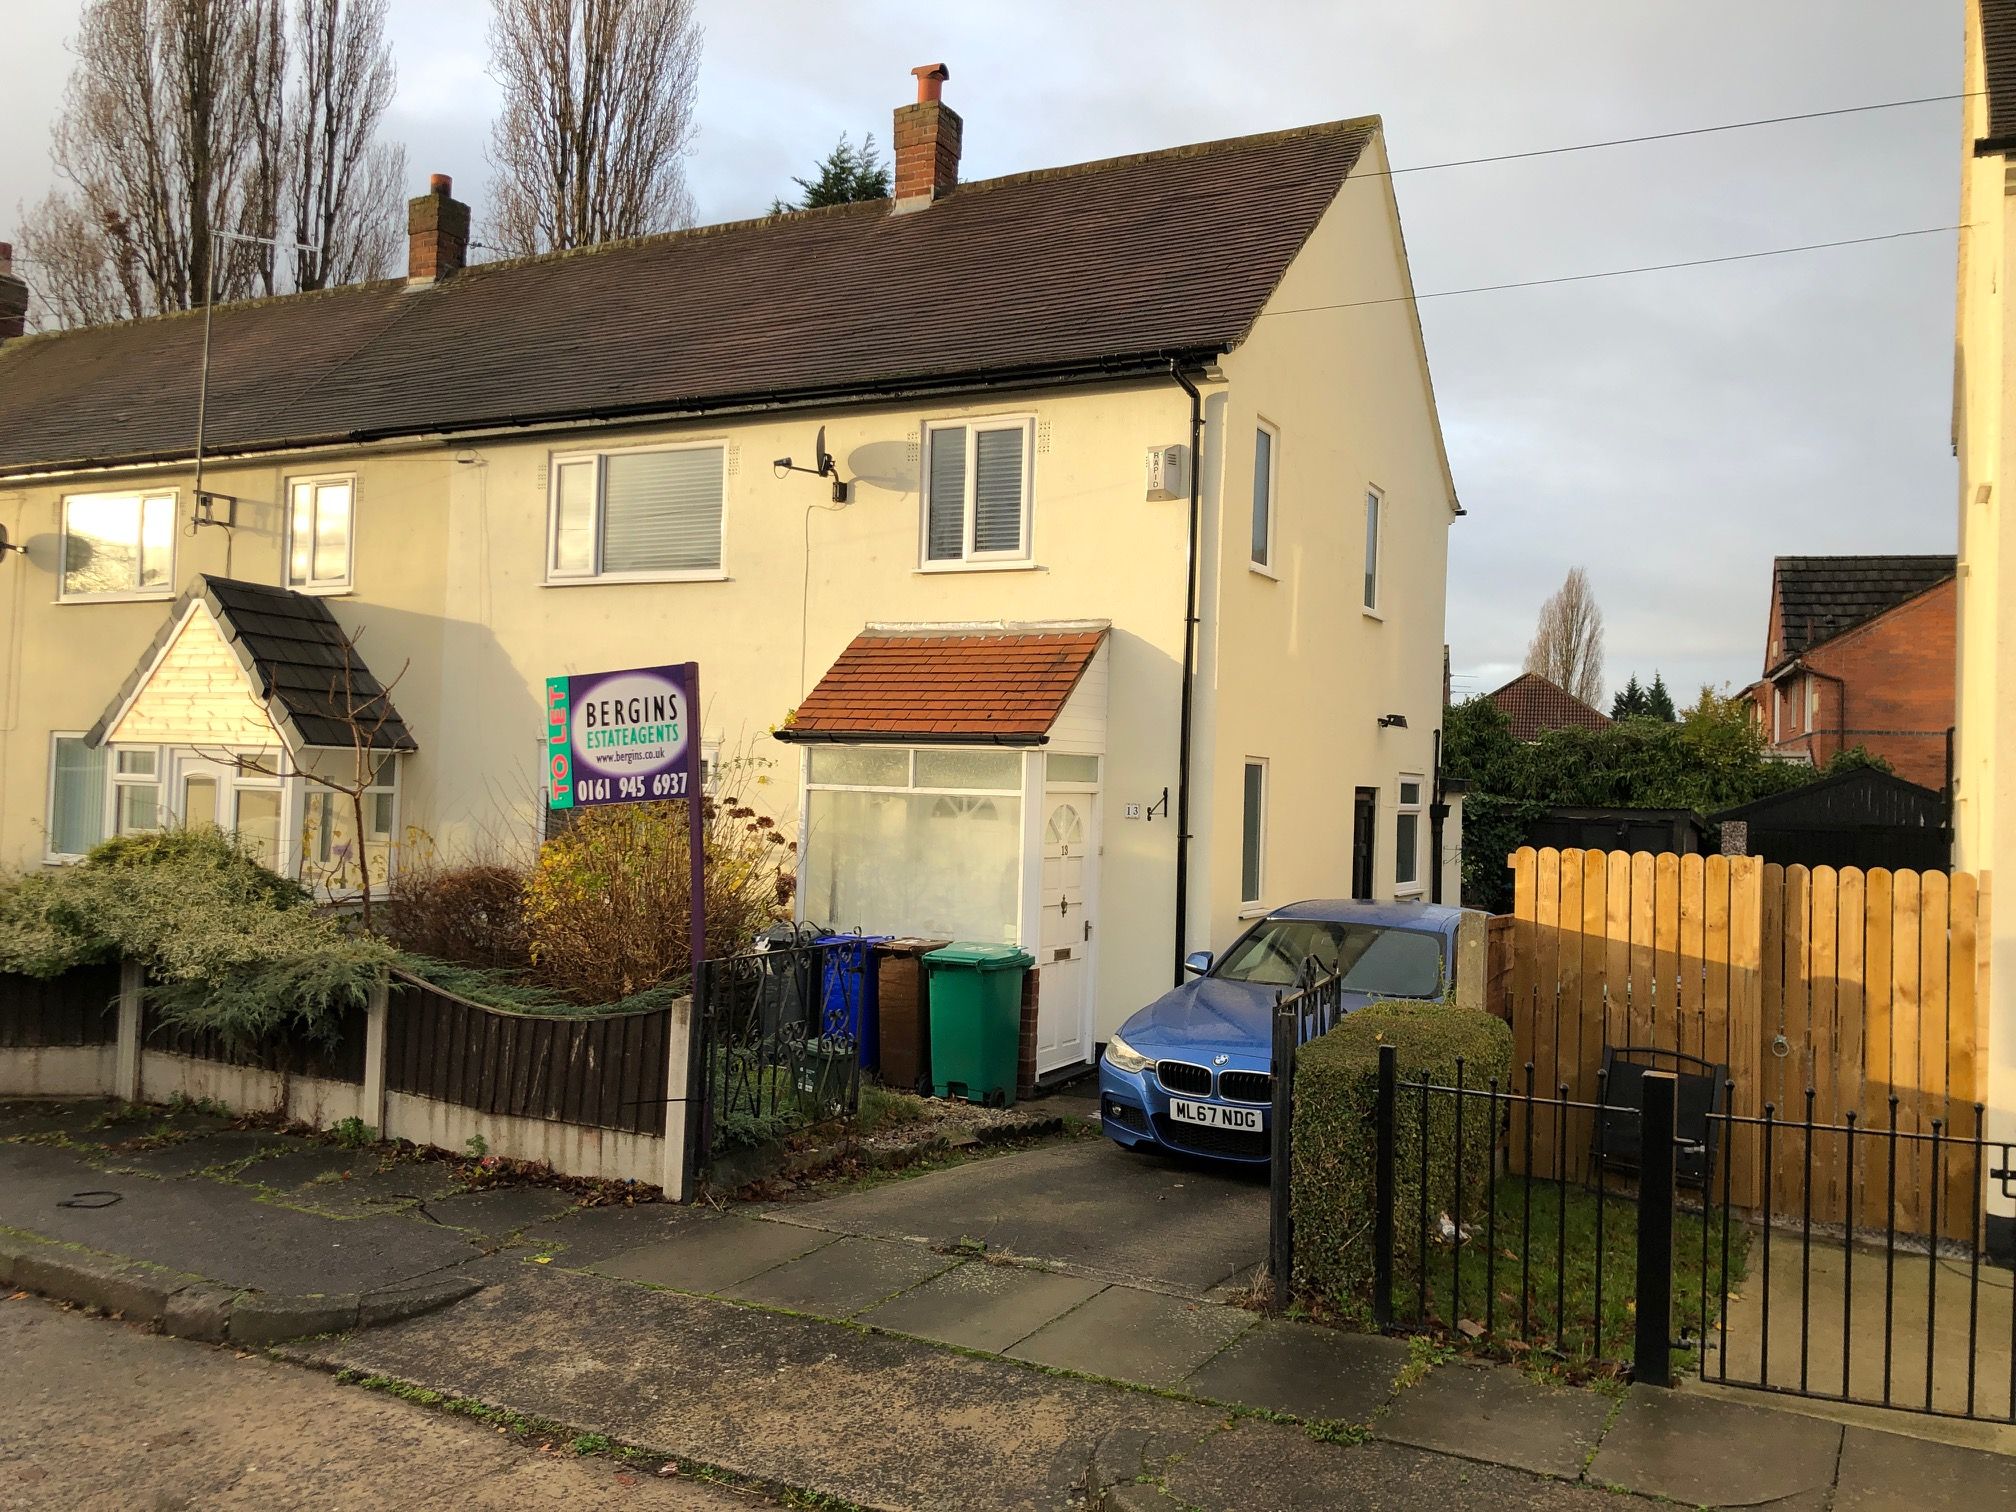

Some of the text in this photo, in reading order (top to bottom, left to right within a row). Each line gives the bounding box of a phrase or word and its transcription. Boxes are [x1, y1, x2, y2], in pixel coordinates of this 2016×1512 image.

[1152, 451, 1160, 488] RAPID
[586, 694, 678, 728] BERGINS
[548, 686, 569, 800] TO LET
[596, 747, 665, 764] www.bergins.co.uk
[577, 772, 688, 801] 0161 945 6937
[1126, 805, 1139, 816] 13
[1061, 845, 1069, 856] 13
[1176, 1102, 1255, 1128] ML67 NDG
